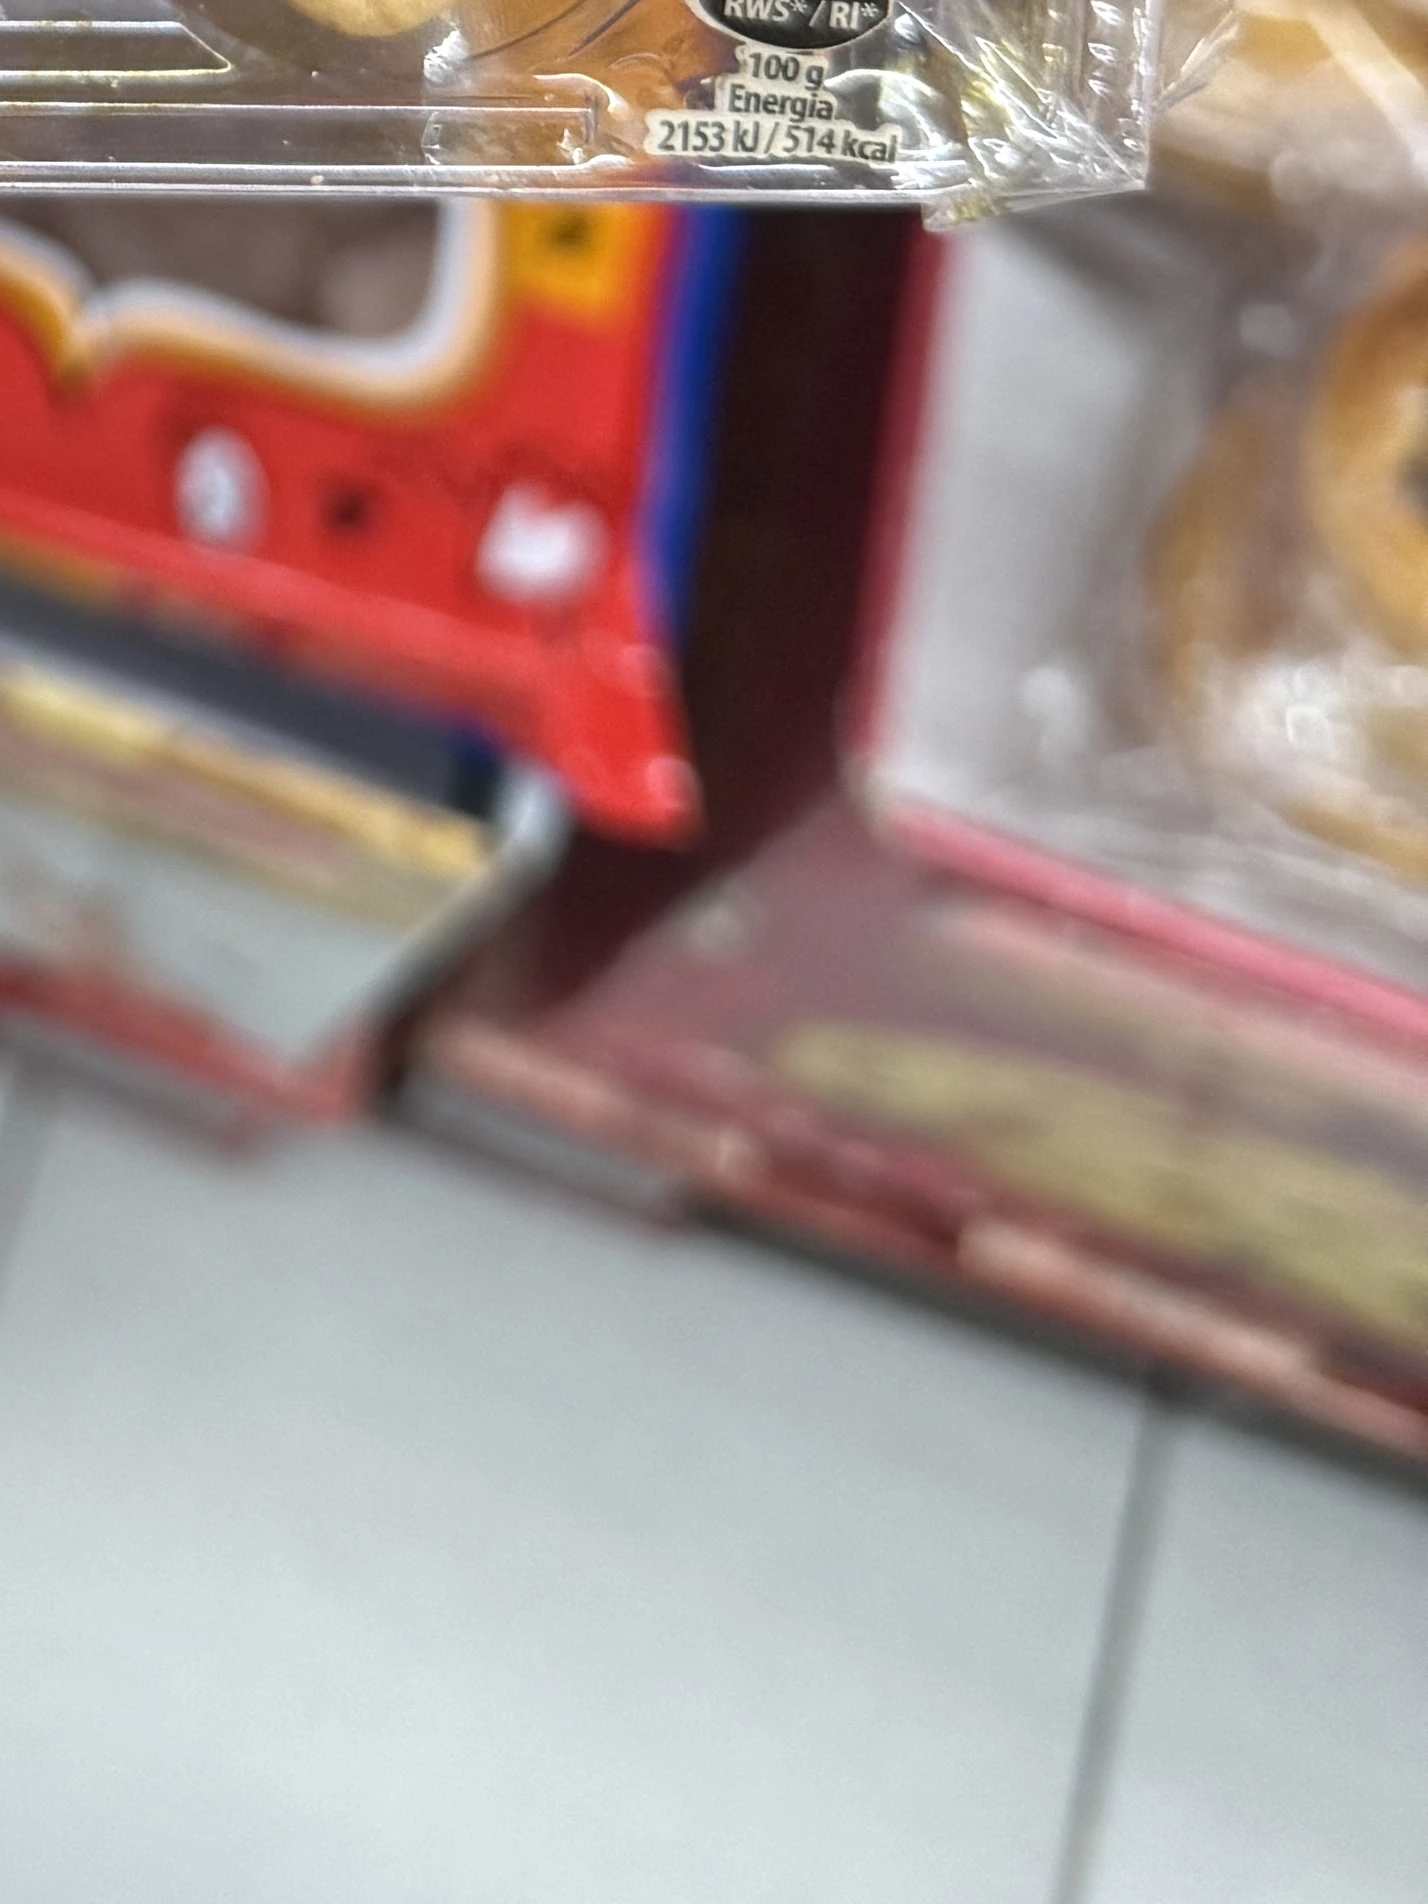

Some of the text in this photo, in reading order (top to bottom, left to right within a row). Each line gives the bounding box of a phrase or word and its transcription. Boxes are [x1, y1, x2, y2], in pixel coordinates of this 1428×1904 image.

[749, 52, 825, 91] 100 g
[728, 83, 835, 123] Energia
[657, 120, 726, 153] 2153
[732, 120, 760, 153] kJ
[783, 124, 836, 155] 514
[840, 128, 899, 164] kcal
